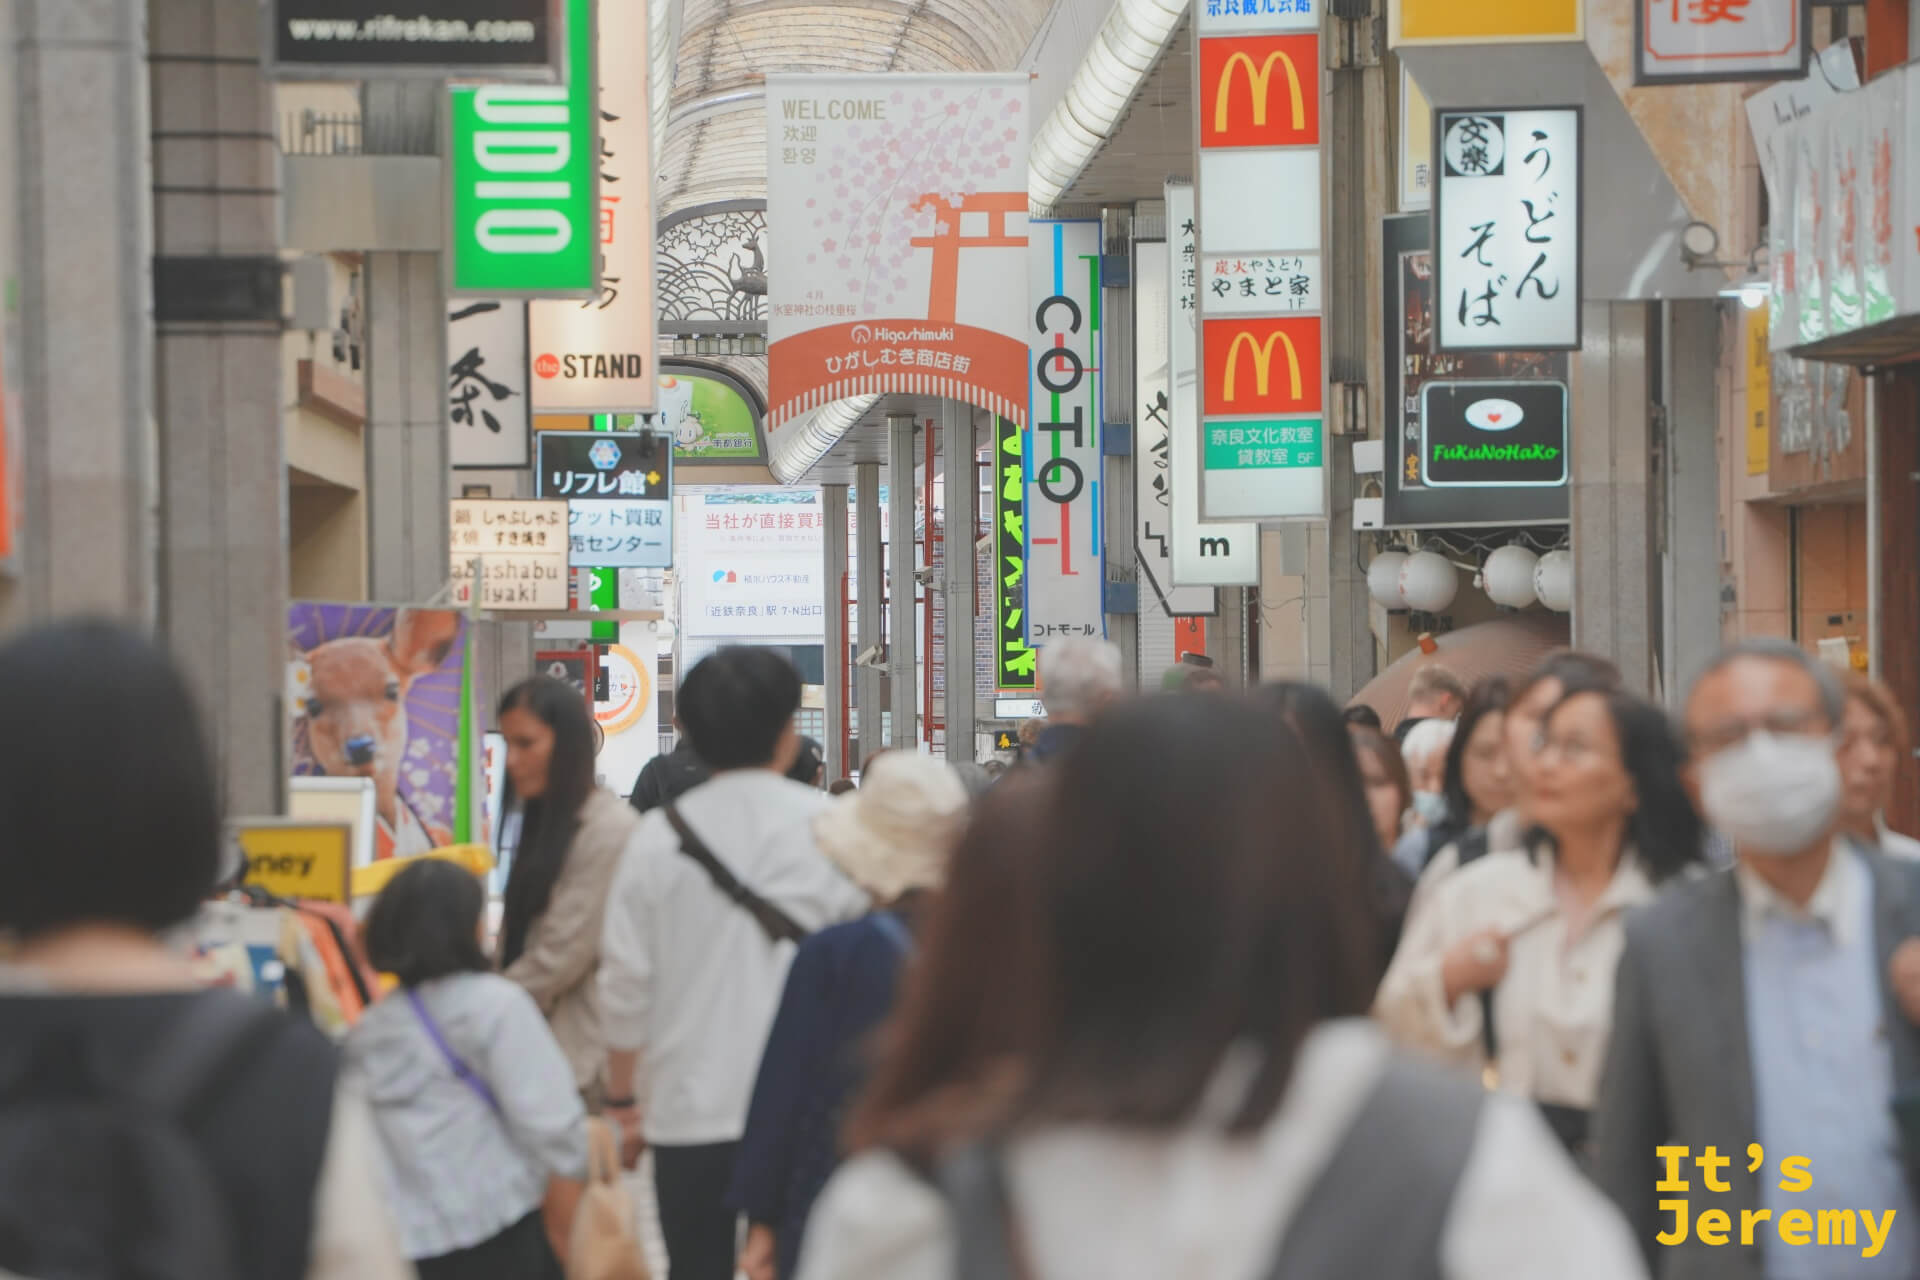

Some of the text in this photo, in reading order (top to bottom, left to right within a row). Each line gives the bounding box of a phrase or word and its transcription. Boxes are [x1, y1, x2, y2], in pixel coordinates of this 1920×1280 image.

[288, 15, 535, 42] www.rifrekan.com
[782, 99, 887, 120] WELCOME
[783, 125, 817, 142] 欢迎
[782, 147, 817, 165] 환영
[1515, 129, 1559, 300] うどん
[1214, 256, 1304, 275] 炭火やきとり
[1457, 220, 1508, 327] そば
[1211, 274, 1310, 298] やまと家
[1288, 297, 1306, 310] 1F
[874, 327, 954, 345] Higashimuki
[563, 353, 642, 379] STAND
[825, 348, 971, 374] ひがしむき商店街
[1211, 427, 1314, 446] 奈良文化教室
[1237, 448, 1315, 465] 貸教室 5F
[553, 469, 647, 495] リフレ館
[483, 509, 560, 526] しゃぶしゃぶ
[1033, 623, 1095, 637] コトモール
